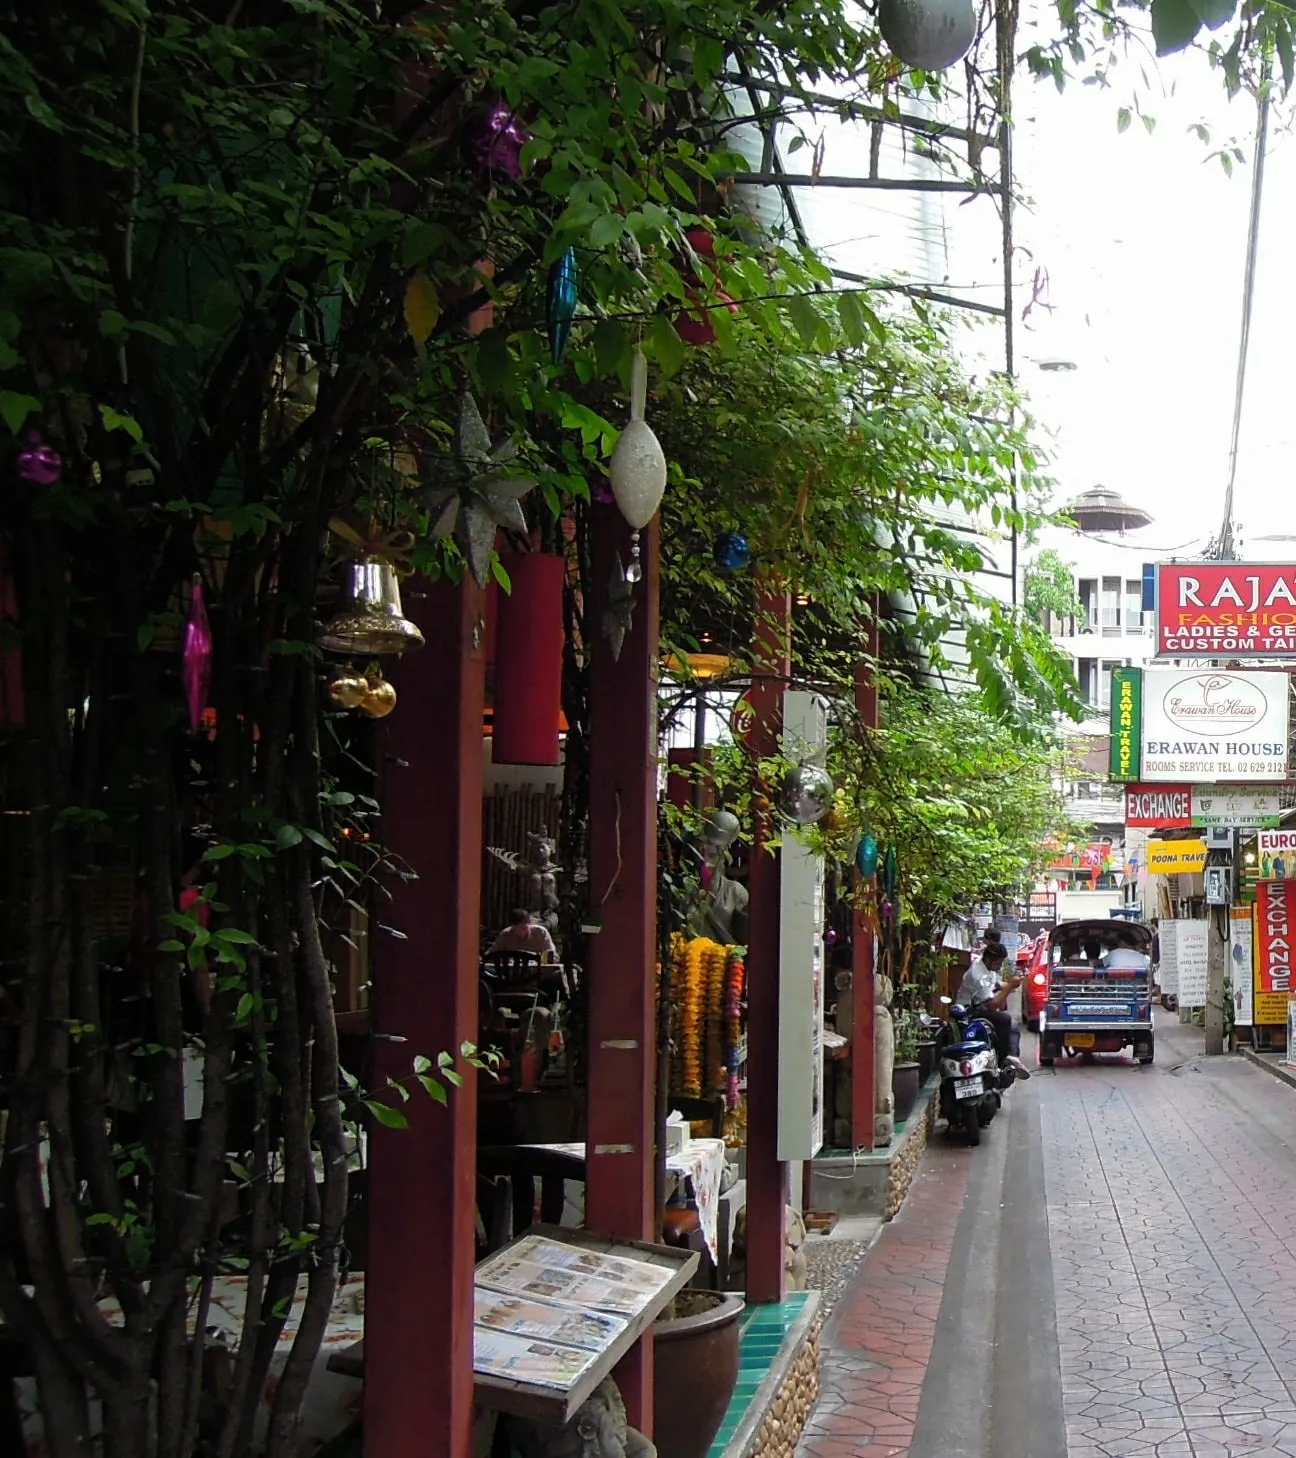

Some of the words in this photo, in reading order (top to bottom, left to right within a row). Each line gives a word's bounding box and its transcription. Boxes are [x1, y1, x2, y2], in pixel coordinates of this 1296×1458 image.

[1164, 625, 1239, 637] LADIES
[1248, 625, 1260, 637] &
[1166, 638, 1254, 650] CUSTOM
[1120, 681, 1133, 727] ERAWAN
[1170, 697, 1216, 715] Erawan
[1217, 699, 1257, 715] House
[1119, 729, 1132, 776] TRAVEL
[1146, 742, 1220, 756] ERAWAN
[1226, 743, 1284, 756] HOUSE
[1145, 760, 1176, 772] ROOMS
[1180, 760, 1214, 773] SERVICE
[1218, 761, 1235, 773] TEL.
[1237, 761, 1248, 773] 02
[1250, 761, 1265, 773] 629
[1128, 792, 1189, 818] EXCHANGE
[1151, 854, 1178, 863] POONA
[1266, 882, 1291, 992] EXCHANGE
